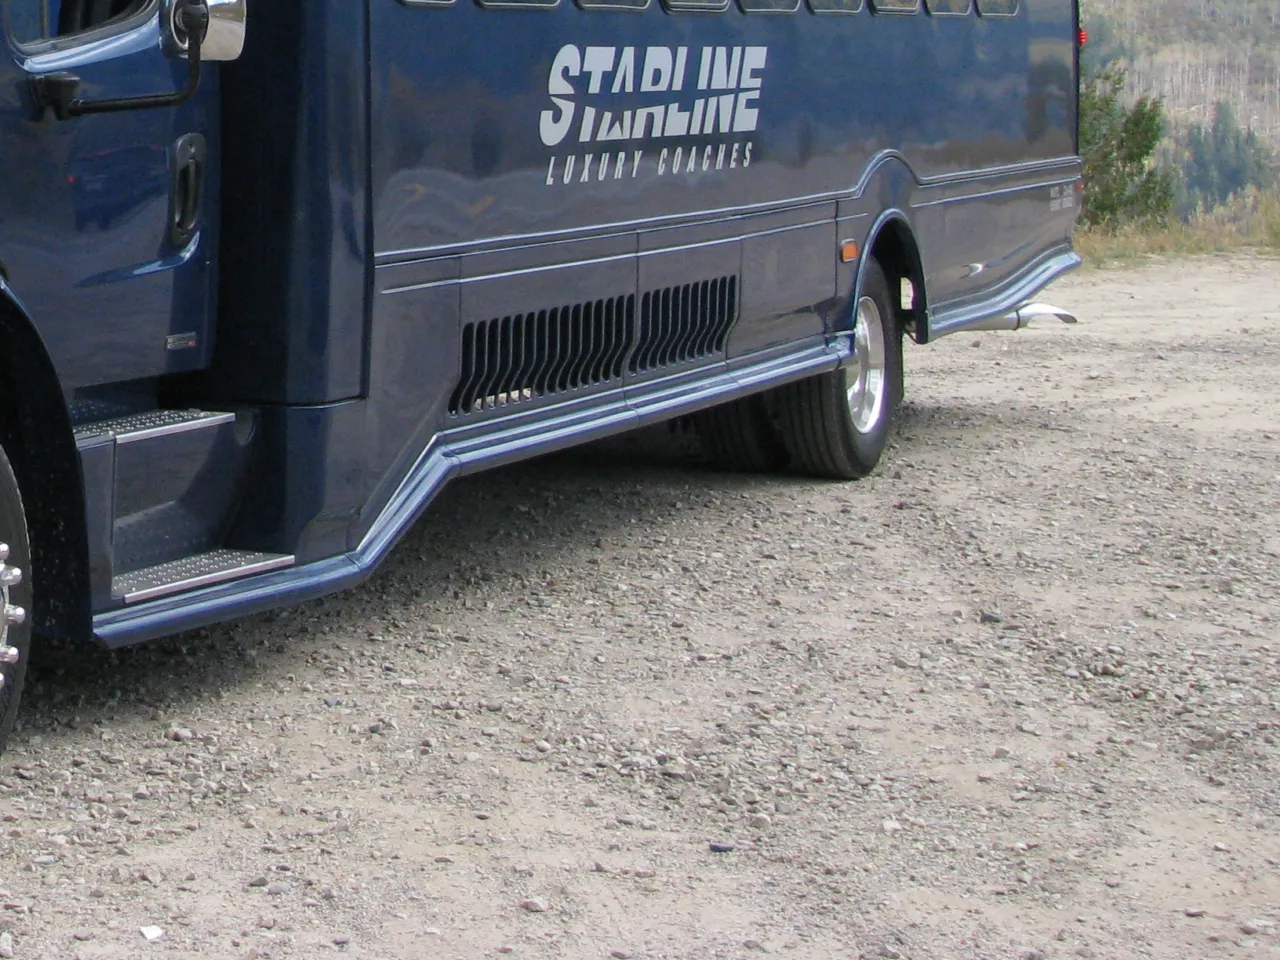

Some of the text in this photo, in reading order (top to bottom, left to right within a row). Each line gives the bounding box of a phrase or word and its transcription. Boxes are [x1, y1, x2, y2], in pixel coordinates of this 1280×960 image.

[539, 43, 768, 146] STARLINE
[546, 141, 753, 185] LUXURY COACHES
